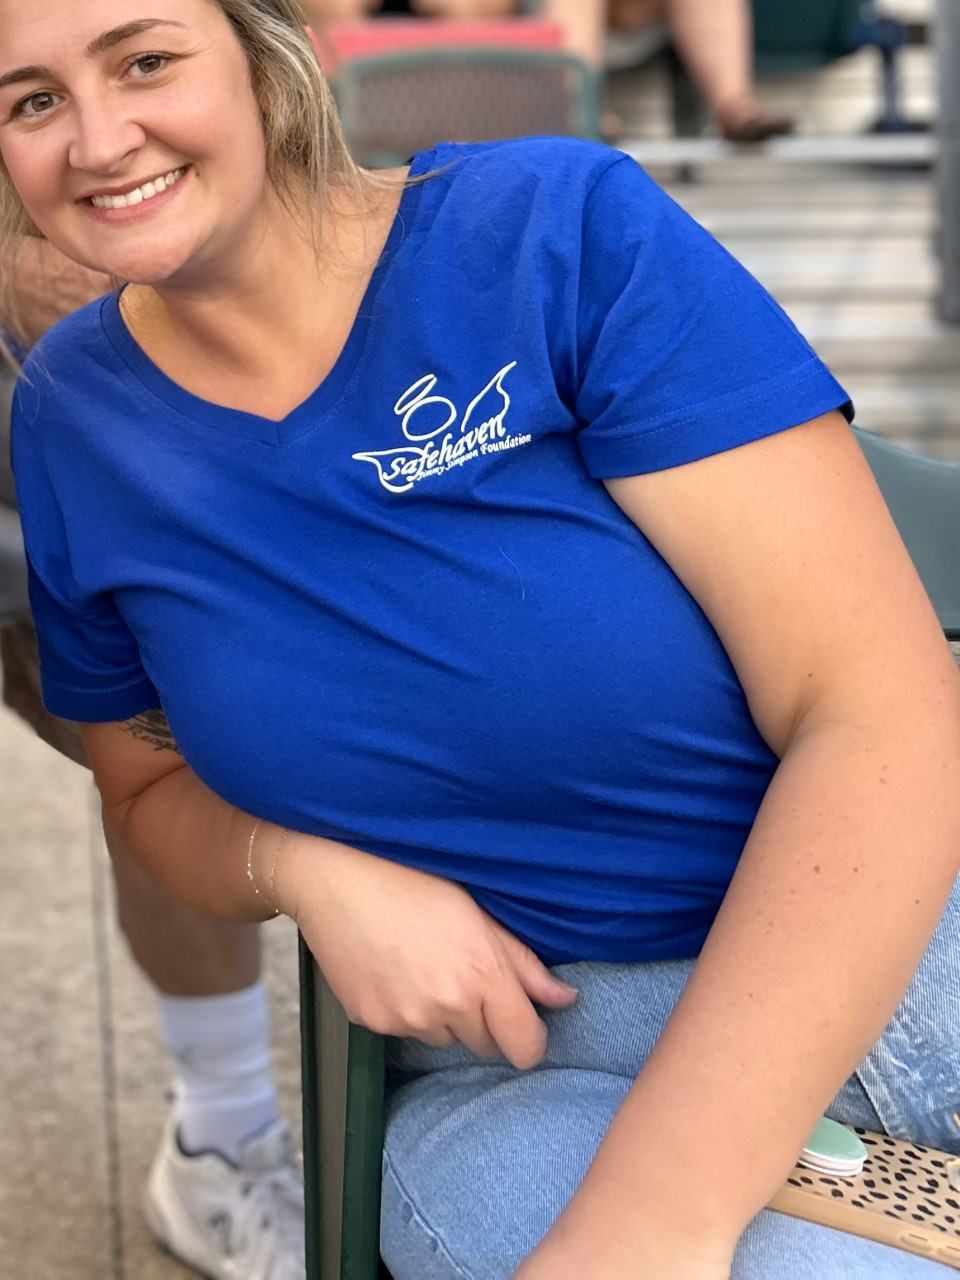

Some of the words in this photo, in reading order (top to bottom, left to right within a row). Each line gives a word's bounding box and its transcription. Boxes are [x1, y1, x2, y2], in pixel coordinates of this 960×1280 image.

[382, 414, 507, 482] Safehaven
[445, 449, 479, 471] Simpson
[480, 433, 532, 455] Foundation
